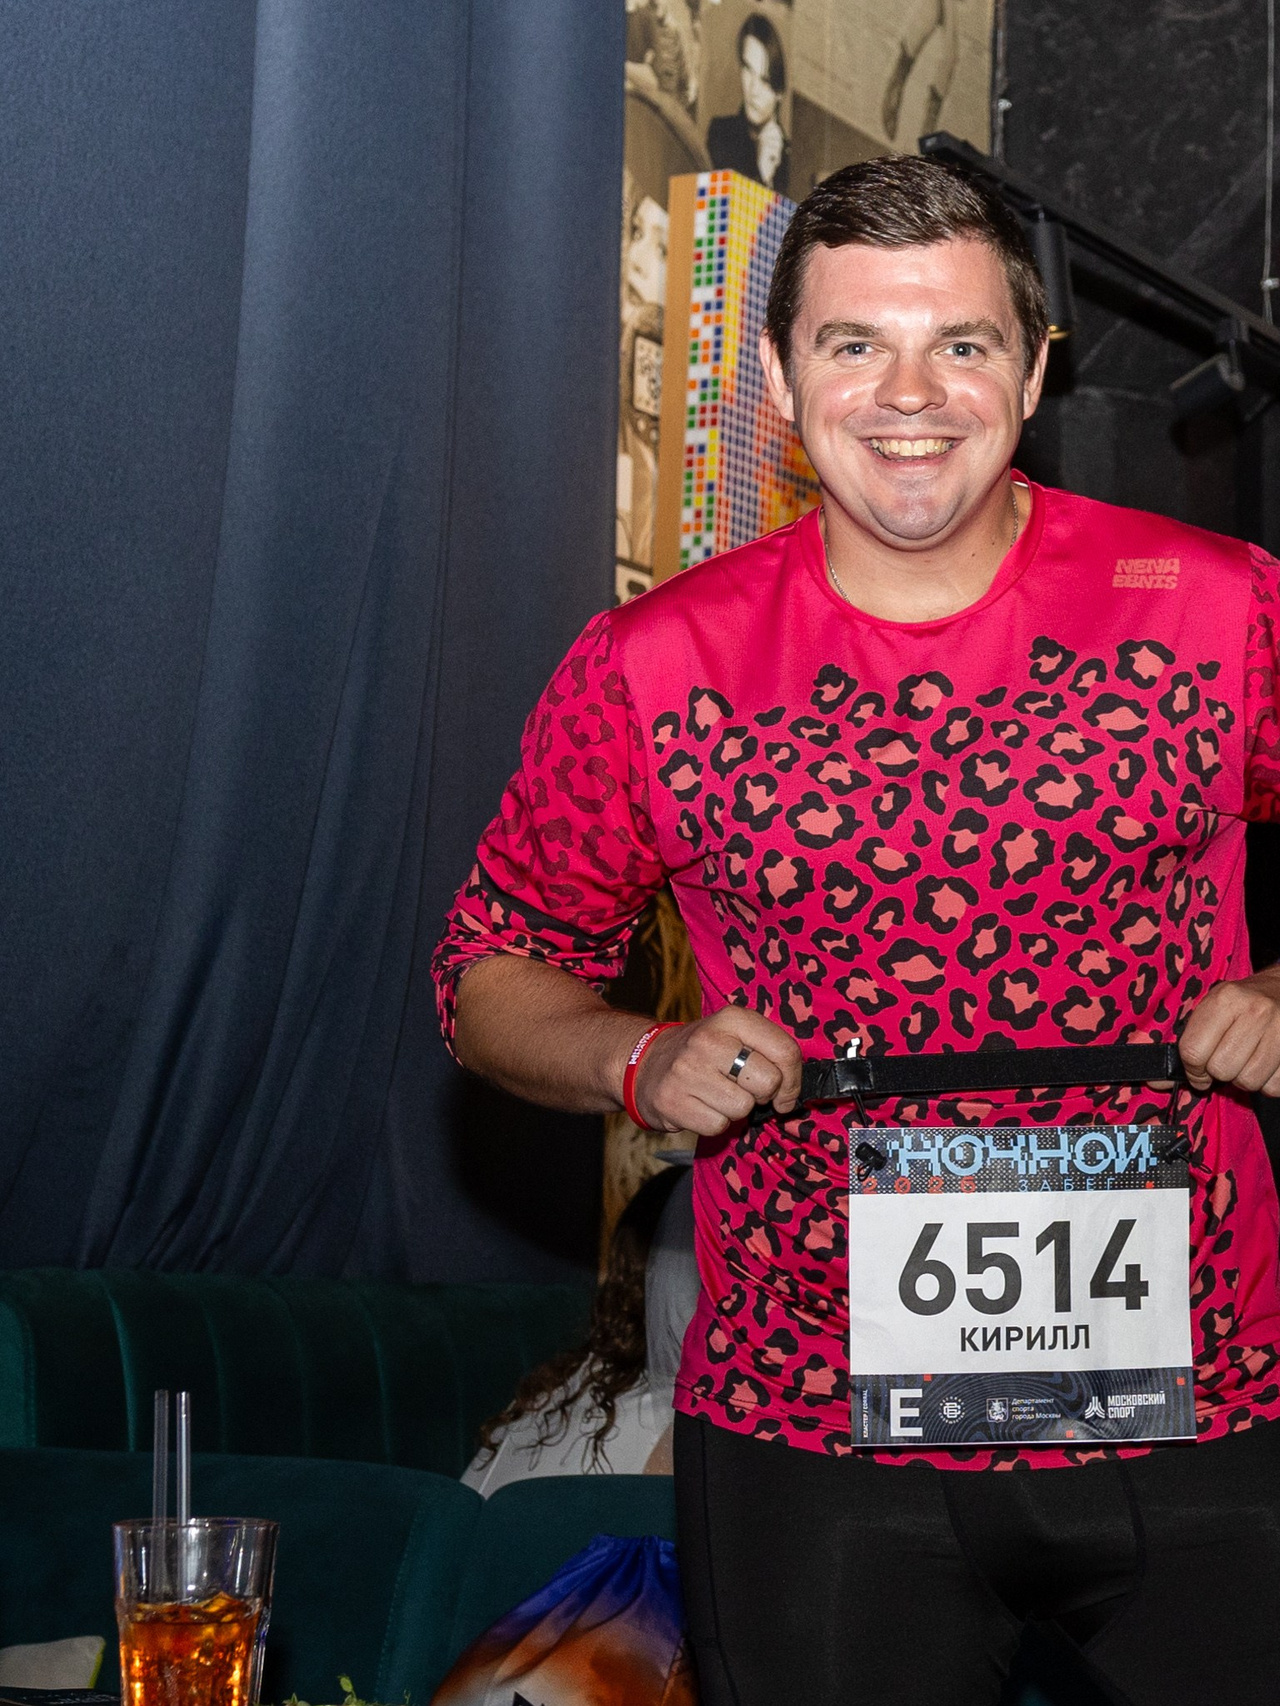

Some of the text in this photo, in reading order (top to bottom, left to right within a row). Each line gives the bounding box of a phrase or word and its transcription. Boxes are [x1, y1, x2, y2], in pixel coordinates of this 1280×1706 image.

[887, 1125, 1158, 1177] НОЧНОЙ
[1019, 1177, 1116, 1192] ЗАБЕГ
[898, 1219, 1149, 1316] 6514
[960, 1324, 1090, 1352] КИРИЛЛ
[1107, 1391, 1166, 1406] МОСКОВСКИЙ
[1108, 1406, 1136, 1419] СПОРТ
